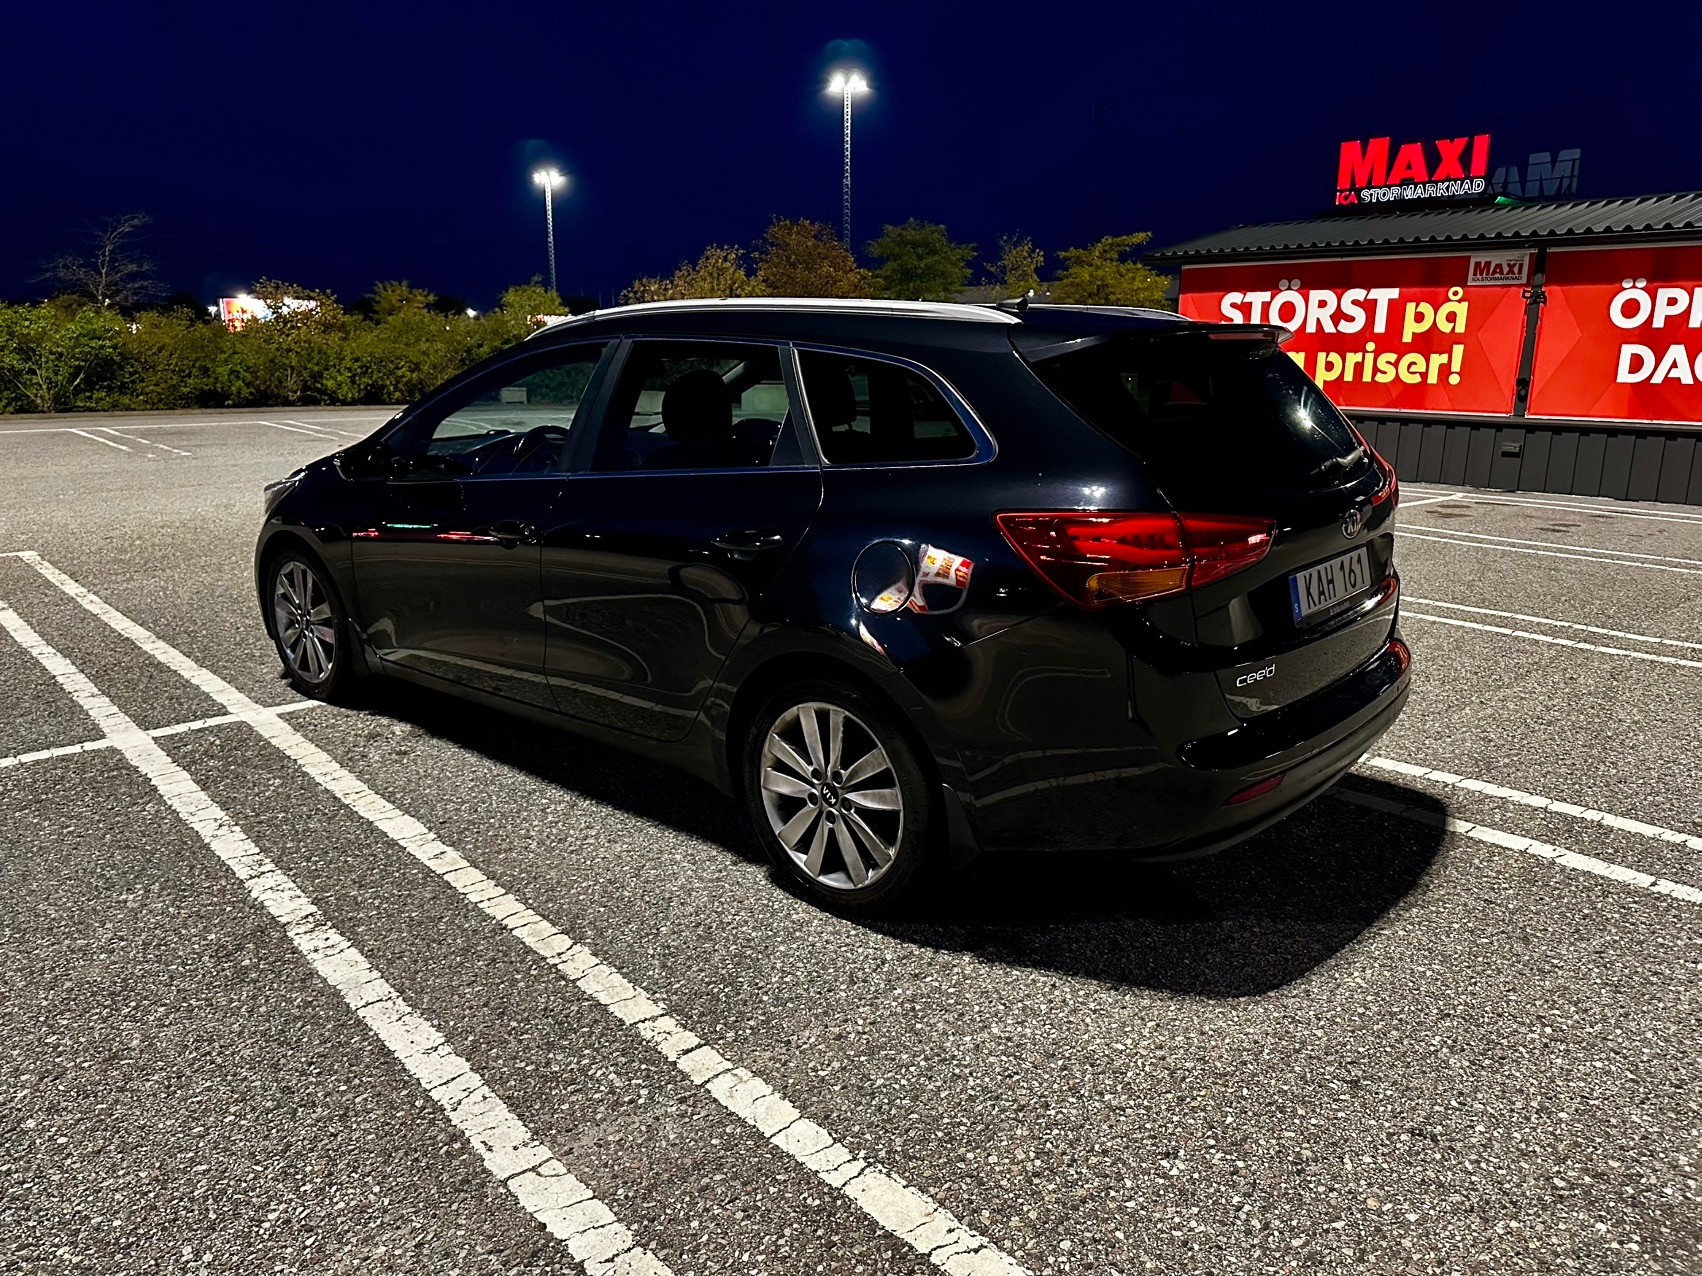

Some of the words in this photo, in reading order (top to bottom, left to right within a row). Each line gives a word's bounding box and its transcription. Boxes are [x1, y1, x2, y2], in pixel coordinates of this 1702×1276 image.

[1337, 134, 1490, 190] MAXI
[1335, 191, 1358, 205] ICA
[1360, 178, 1486, 203] STORMARKNAD
[1473, 261, 1523, 276] MAXI
[1220, 279, 1400, 334] STÖRST
[1402, 286, 1469, 343] på
[1315, 341, 1465, 391] priser!
[1616, 343, 1702, 385] DA
[1303, 564, 1337, 610] KAH
[1339, 553, 1365, 593] 161
[1236, 663, 1276, 687] cee'd
